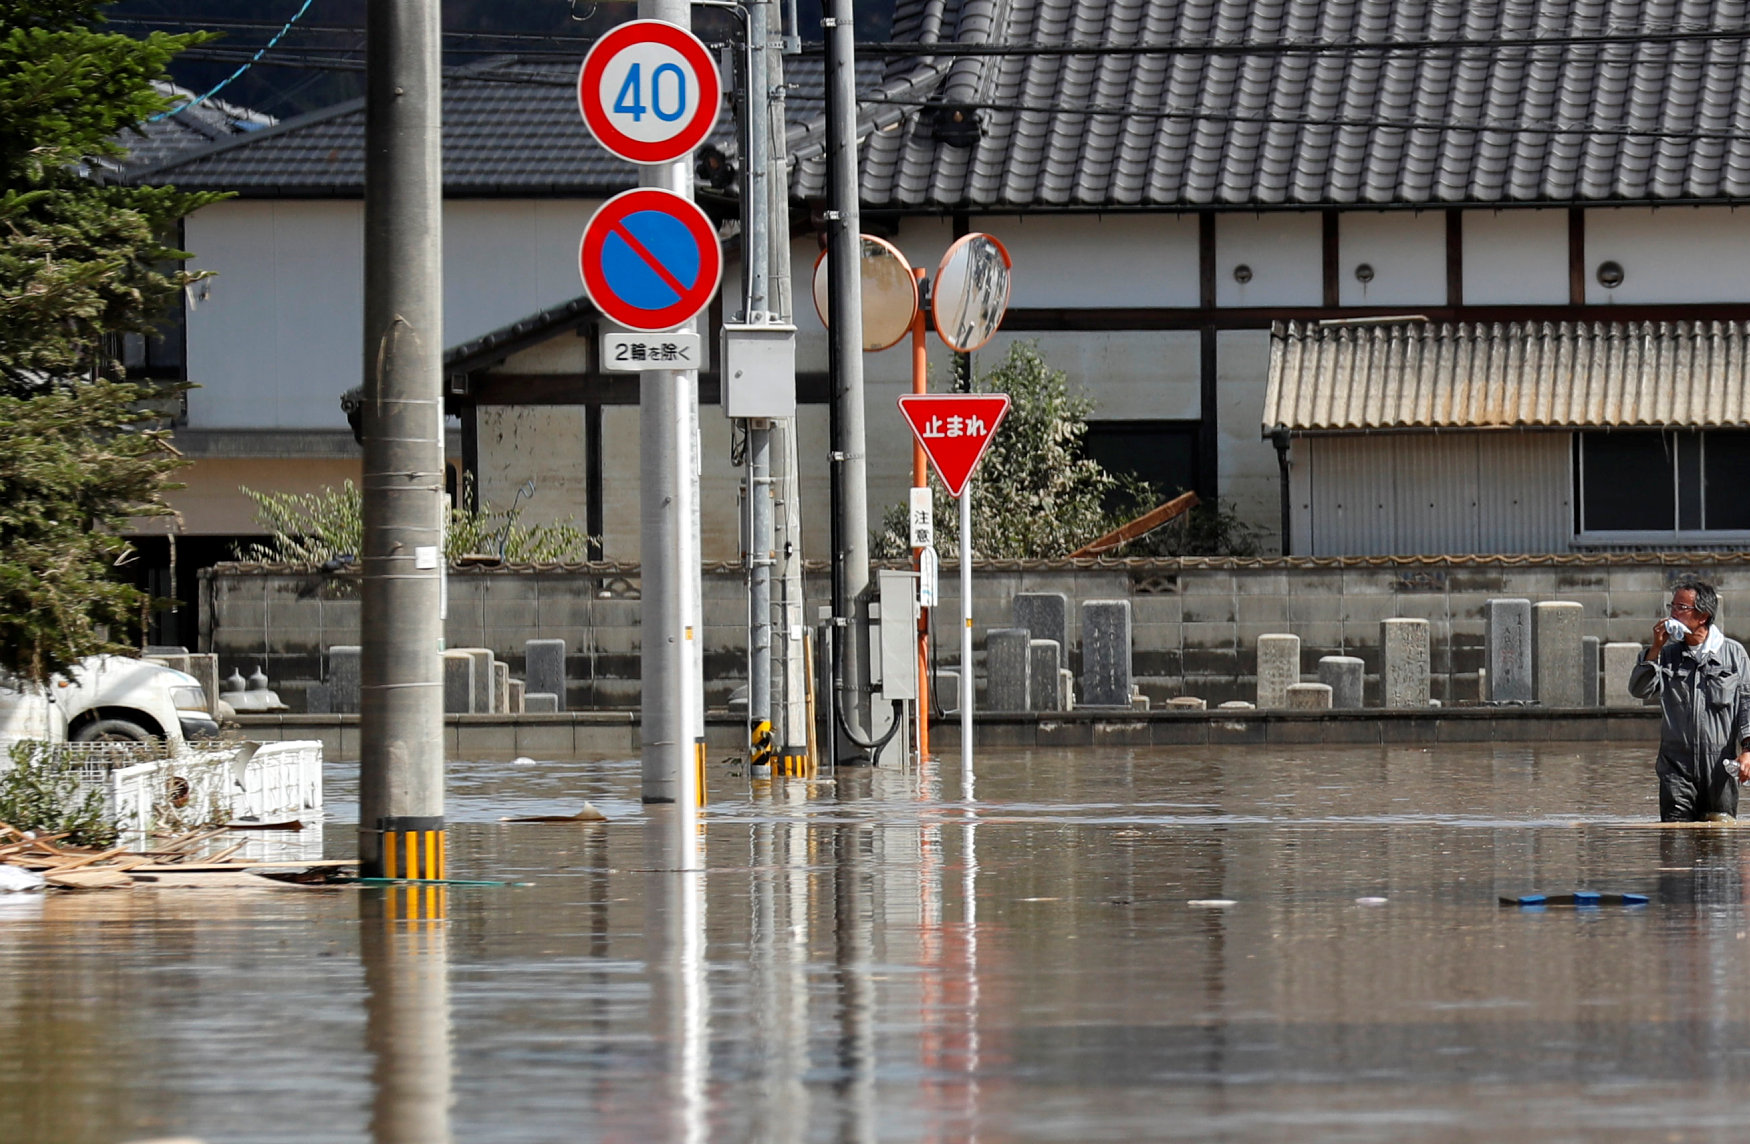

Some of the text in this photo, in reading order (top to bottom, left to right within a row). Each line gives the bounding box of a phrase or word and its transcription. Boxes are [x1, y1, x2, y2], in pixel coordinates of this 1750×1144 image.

[613, 62, 687, 122] 40
[615, 342, 691, 361] 2輪を除く
[922, 414, 988, 438] 止まれ
[914, 509, 931, 543] 注意
